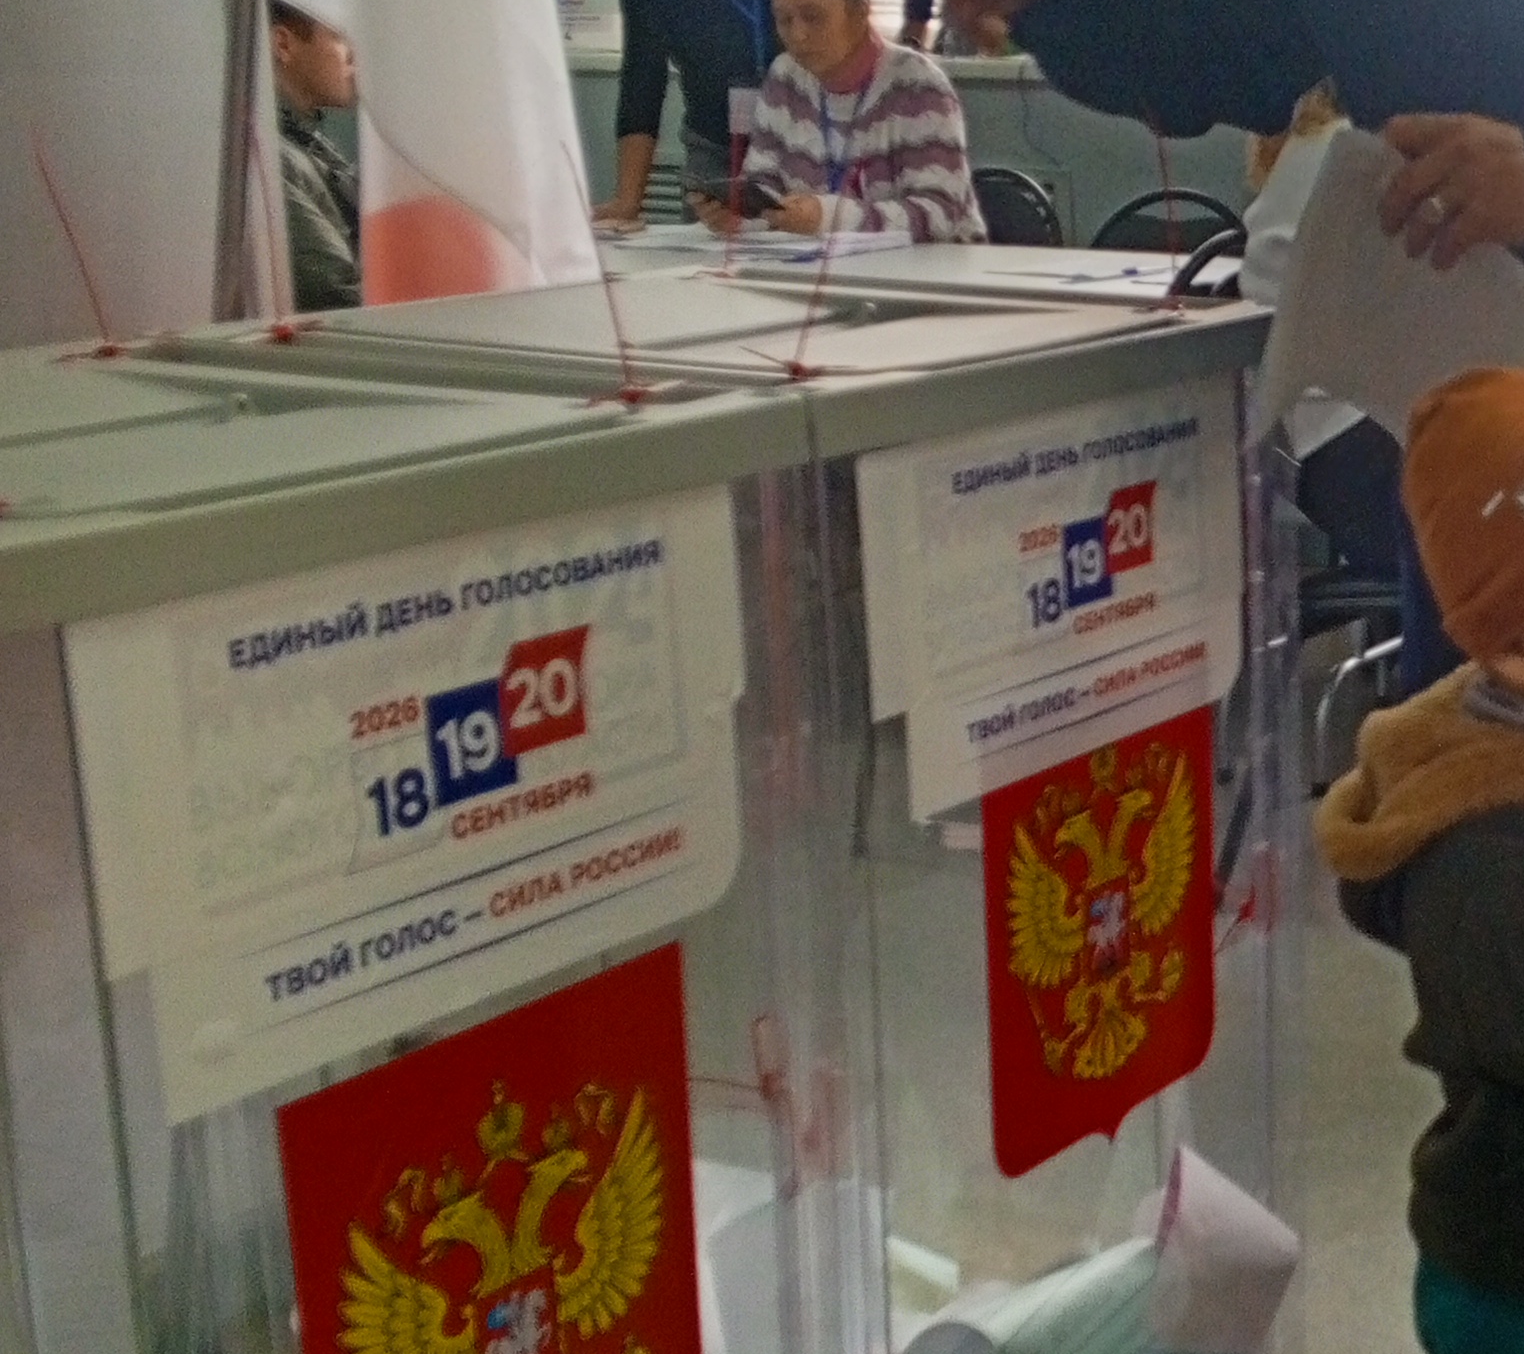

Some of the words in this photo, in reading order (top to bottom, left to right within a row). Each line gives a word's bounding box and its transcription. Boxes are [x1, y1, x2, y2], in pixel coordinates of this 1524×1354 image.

[952, 450, 1031, 495] ЕДИНЫЙ
[1034, 447, 1079, 478] ДЕНЬ
[1082, 416, 1198, 462] ГОЛОСОВАНИЯ
[228, 600, 368, 670] ЕДИНЫЙ
[374, 589, 455, 637] ДЕНЬ
[459, 539, 664, 611] ГОЛОСОВАНИЯ
[1026, 577, 1063, 629] 18
[1067, 538, 1103, 588] 19
[1107, 503, 1149, 555] 20
[350, 696, 420, 739] 2026
[366, 767, 429, 836] 18
[436, 710, 502, 780] 19
[506, 658, 579, 728] 20
[966, 702, 1017, 743] ТВОЙ
[1019, 687, 1077, 723] ГОЛОС
[451, 771, 594, 840] СЕНТЯБРЯ
[264, 937, 355, 1003] ТВОЙ
[358, 909, 458, 968] ГОЛОС
[488, 871, 563, 919] СИЛА
